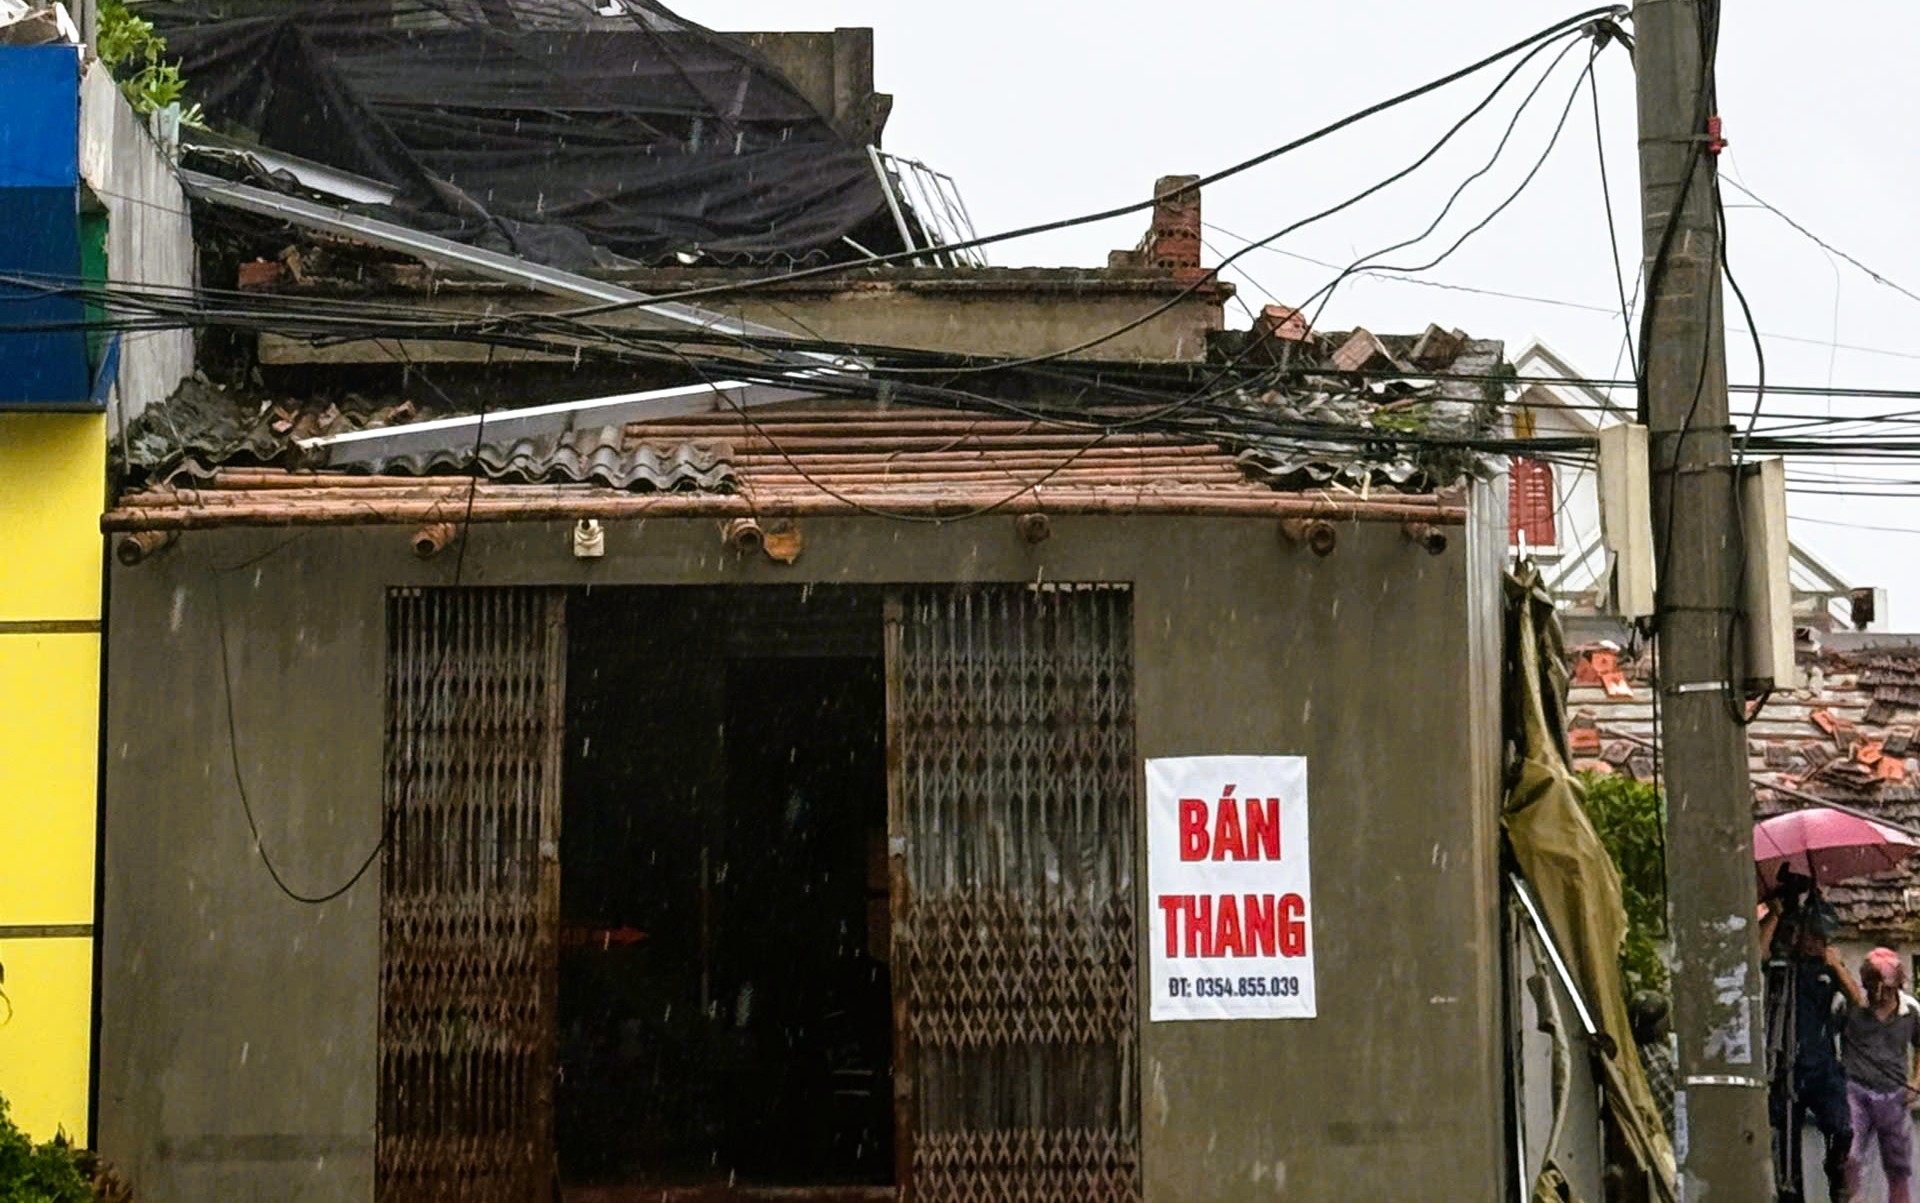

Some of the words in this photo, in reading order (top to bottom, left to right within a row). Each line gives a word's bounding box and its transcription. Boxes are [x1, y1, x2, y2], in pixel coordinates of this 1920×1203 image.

[1179, 784, 1281, 862] BÁN
[1158, 893, 1306, 958] THANG
[1168, 977, 1192, 998] ĐT:
[1196, 976, 1299, 997] 0354.855.039
